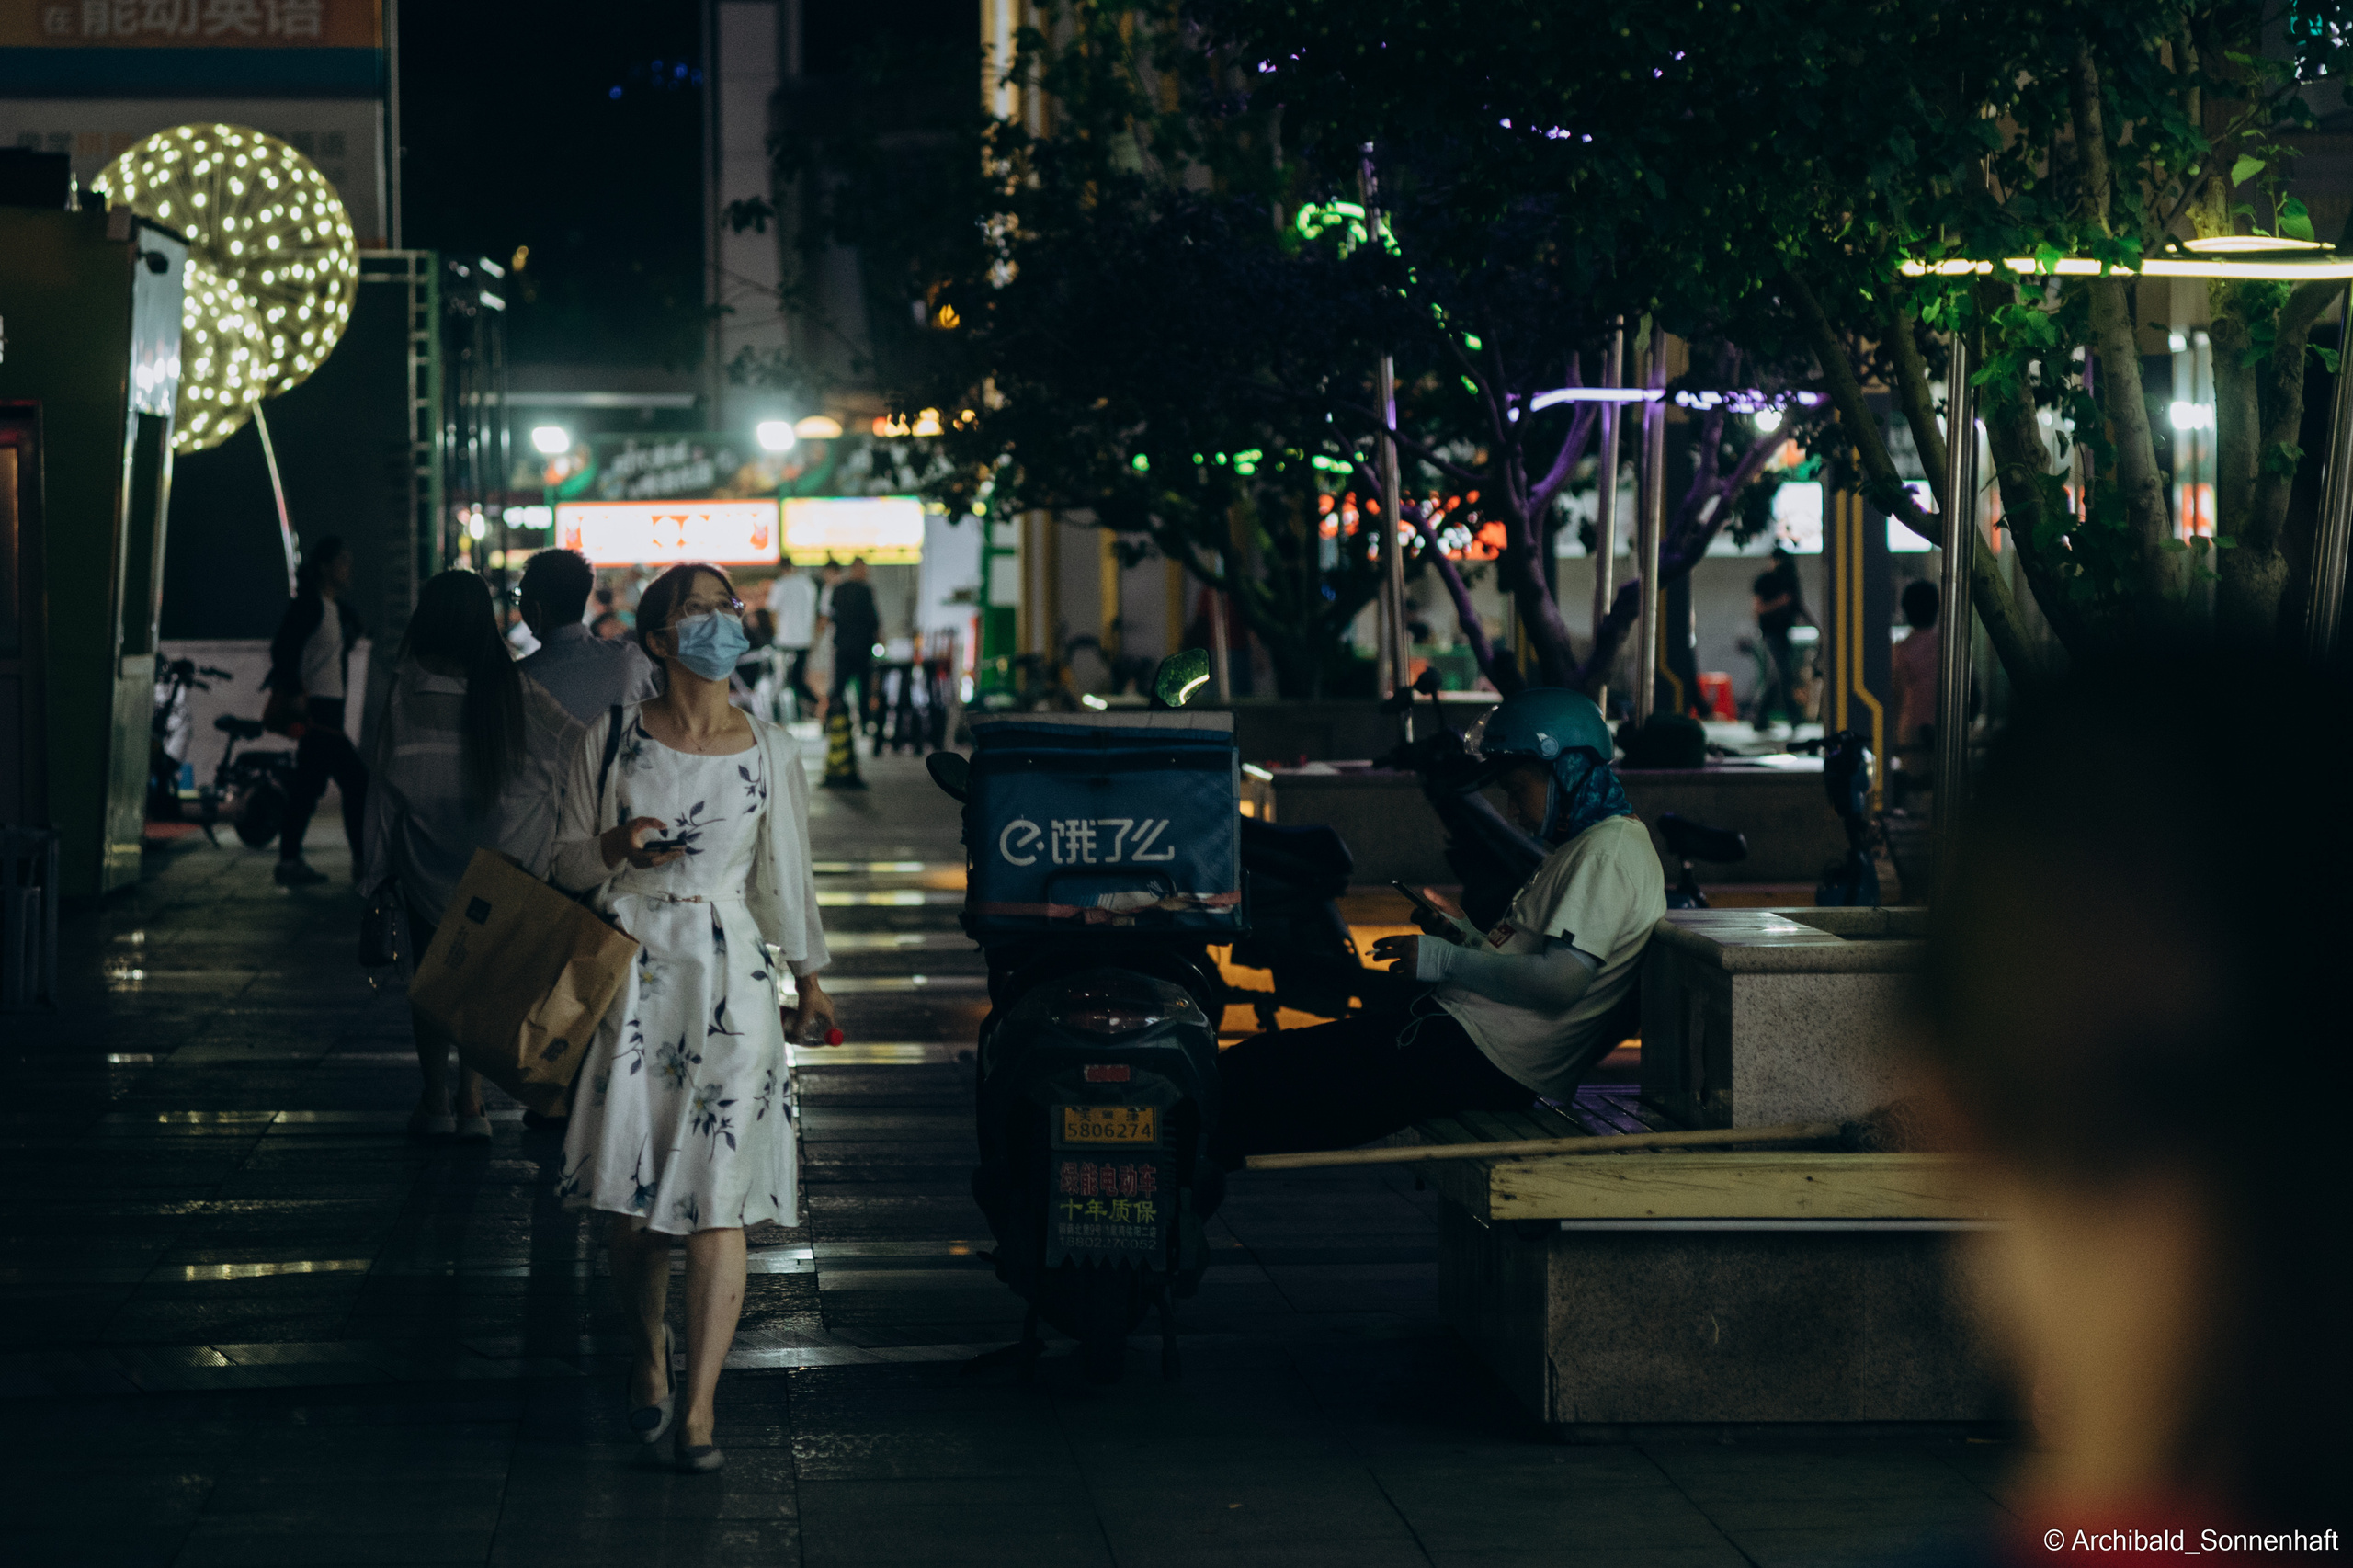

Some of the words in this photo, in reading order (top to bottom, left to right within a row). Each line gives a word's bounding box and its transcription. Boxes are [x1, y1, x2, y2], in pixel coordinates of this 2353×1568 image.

[1067, 1123, 1151, 1139] 5806274
[1060, 1198, 1157, 1223] 十年质保
